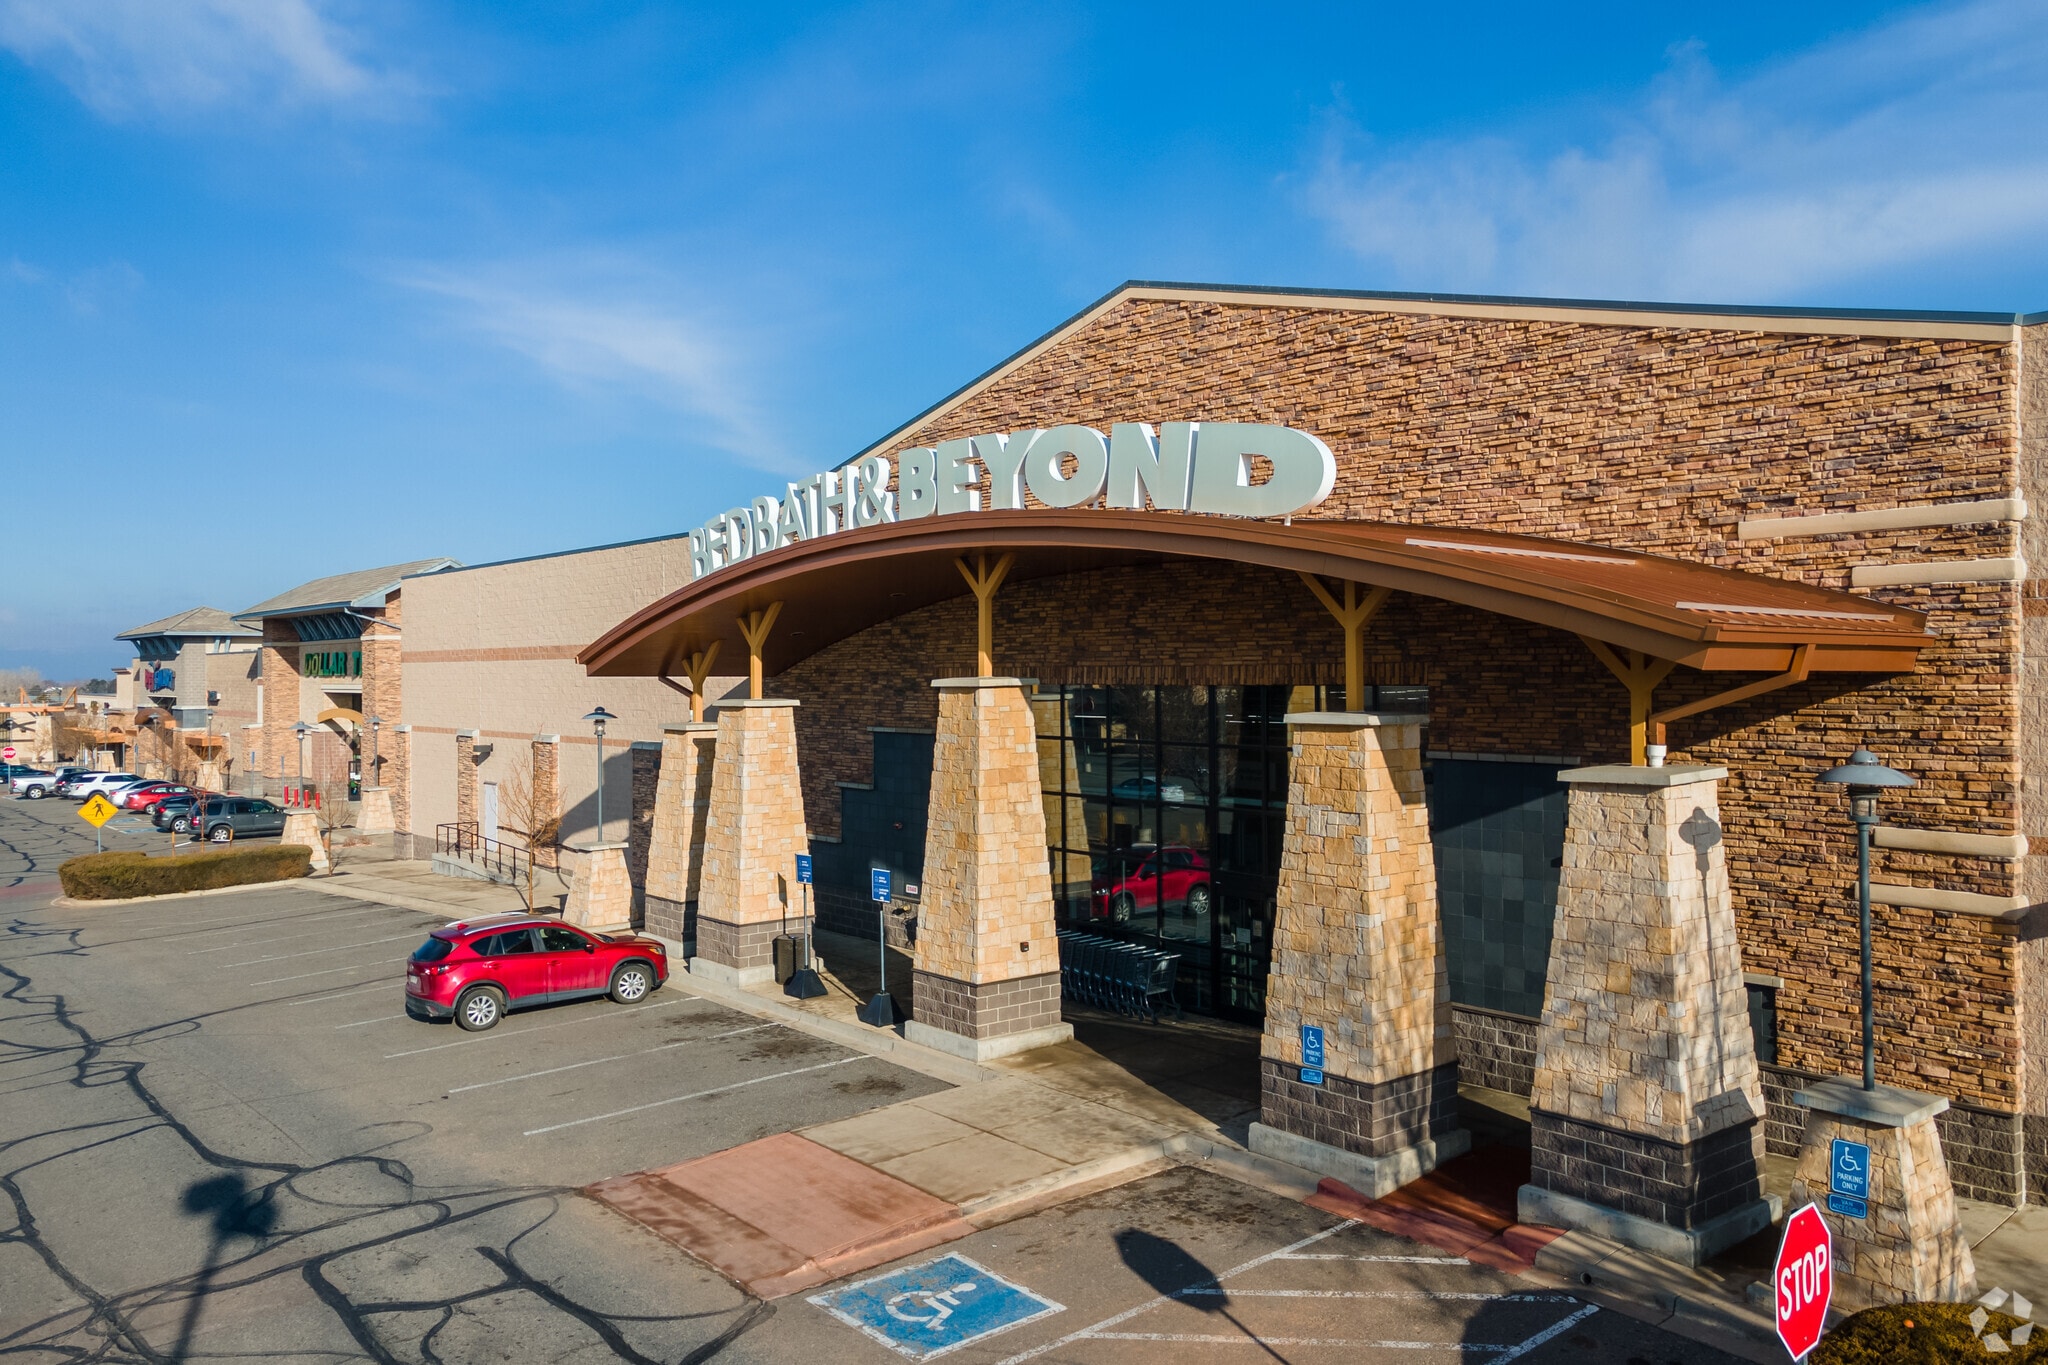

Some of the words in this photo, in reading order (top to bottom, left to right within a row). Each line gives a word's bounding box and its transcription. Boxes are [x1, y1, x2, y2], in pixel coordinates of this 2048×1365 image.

[898, 422, 1336, 522] BEYOND
[304, 651, 347, 678] DOLLAR
[1836, 1171, 1864, 1185] PARKING
[1841, 1181, 1858, 1191] ONLY
[1779, 1243, 1827, 1321] STOP
